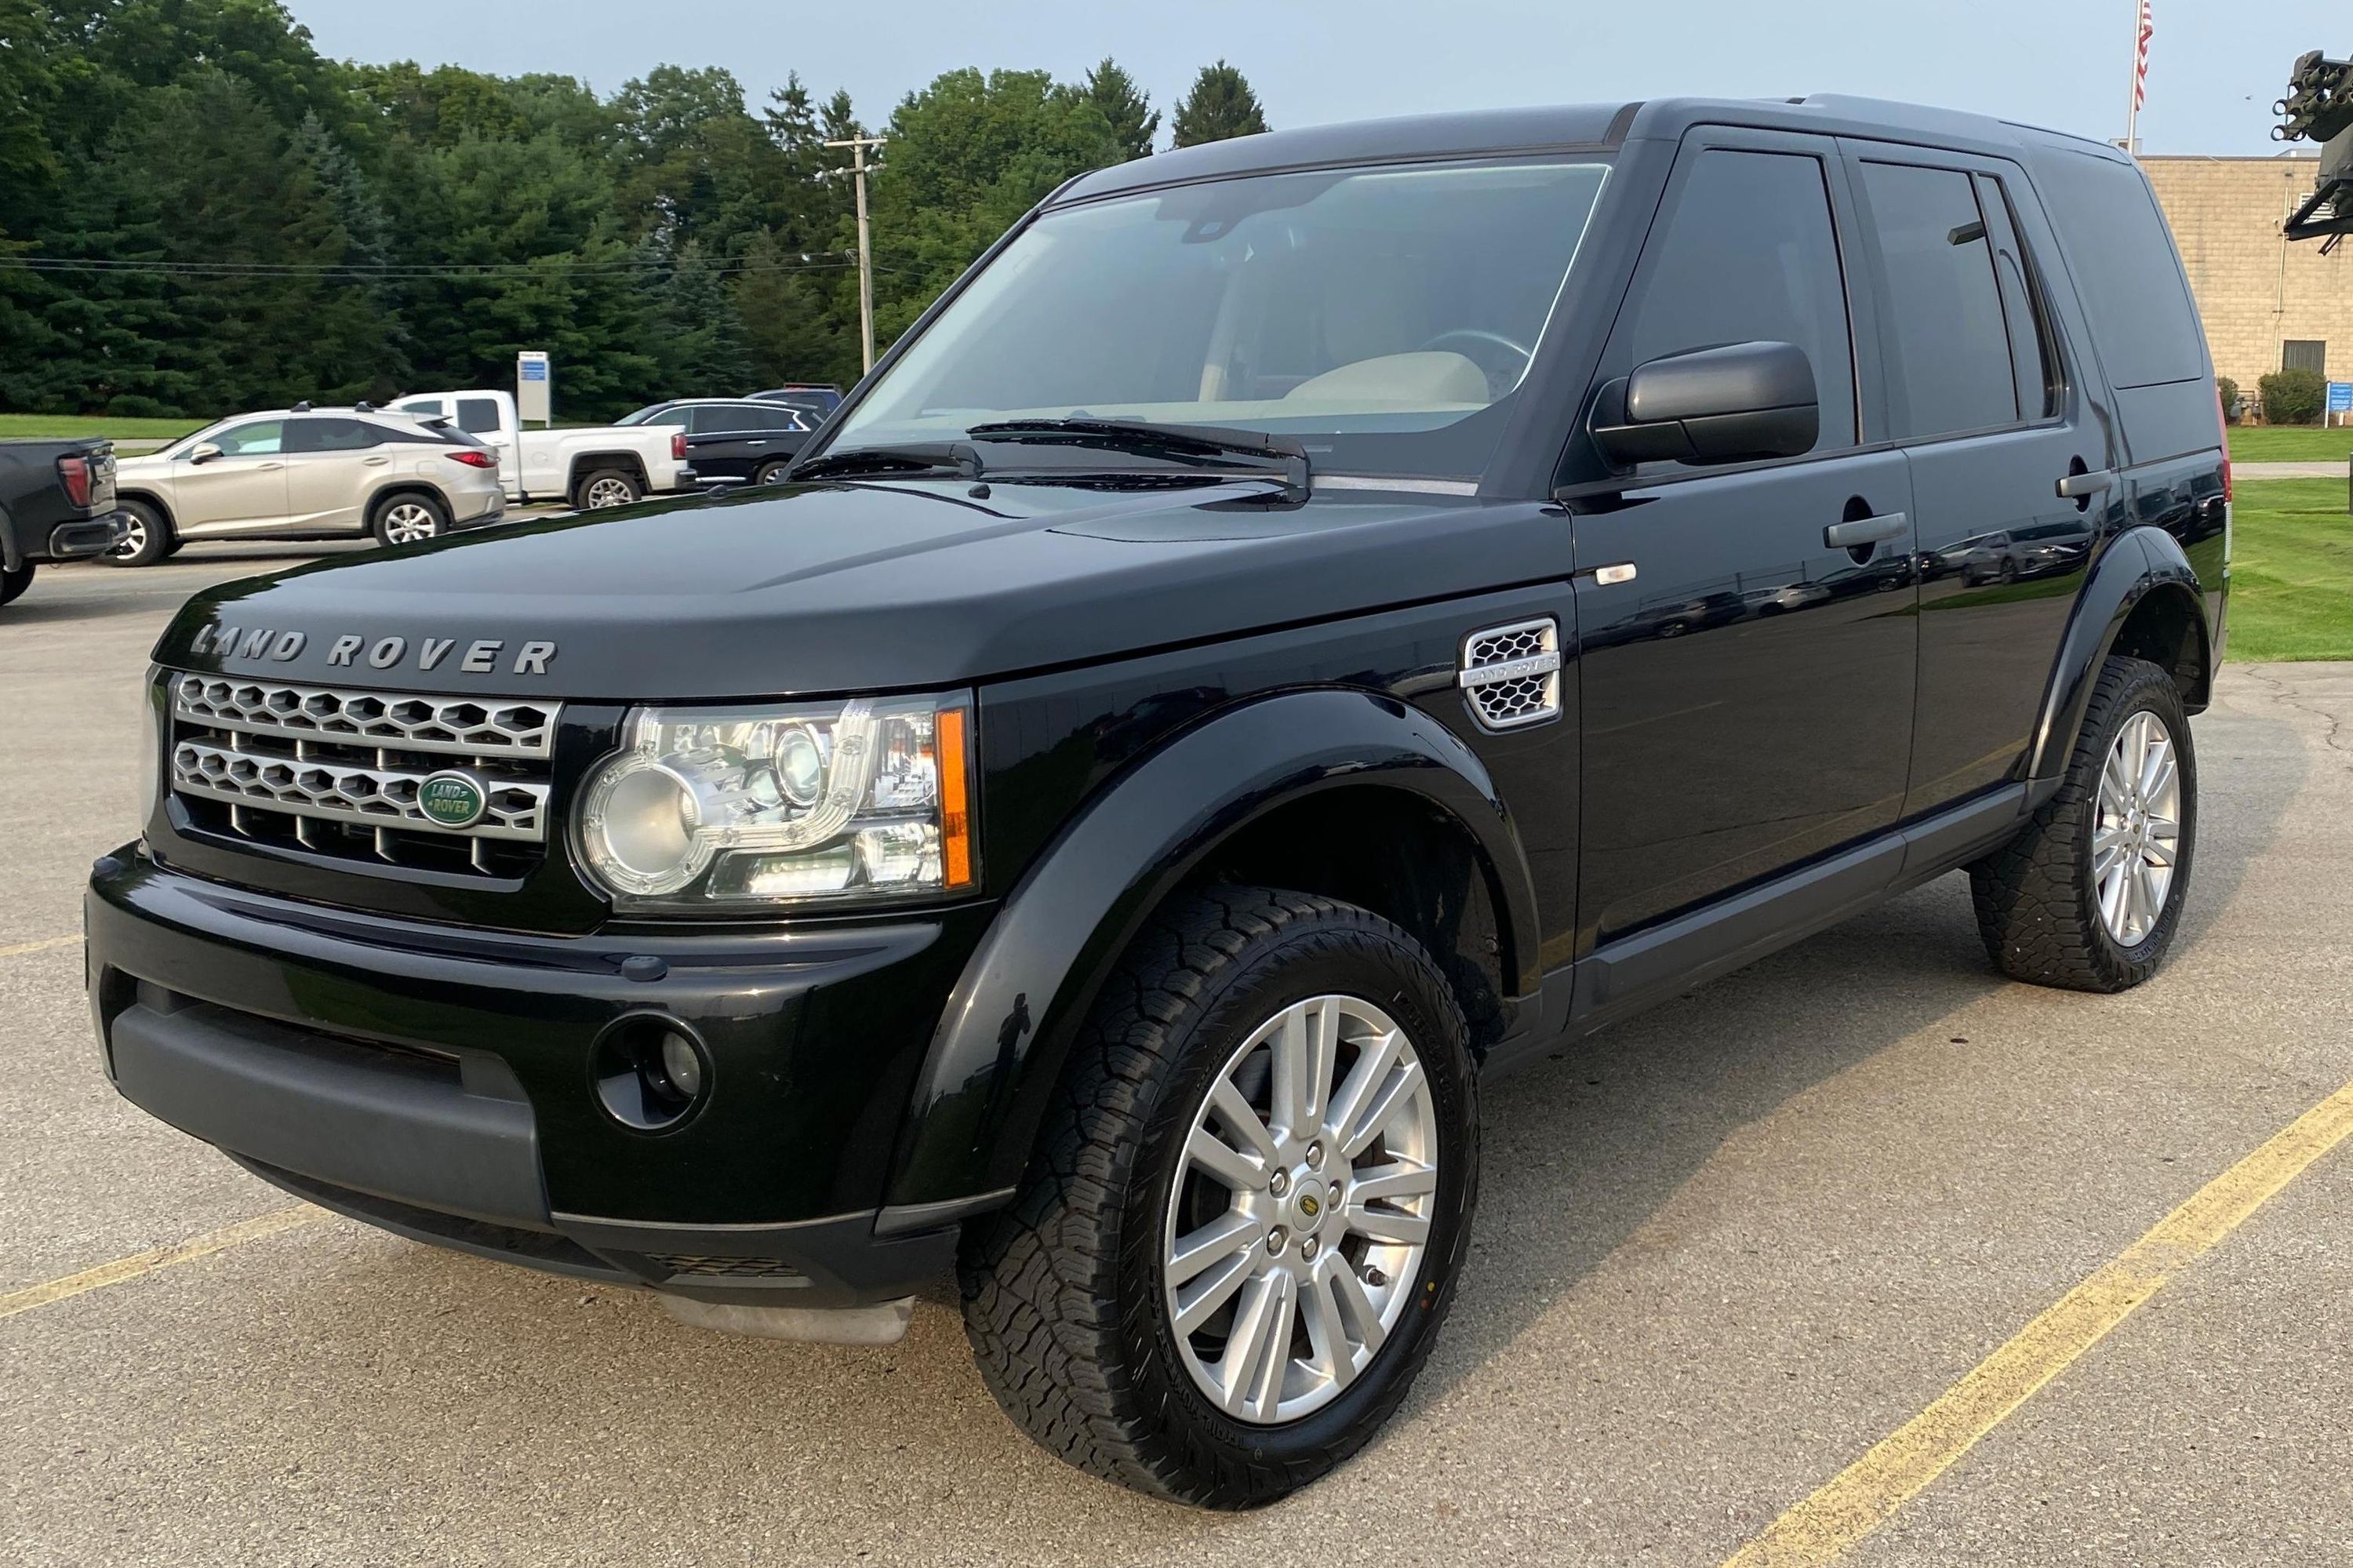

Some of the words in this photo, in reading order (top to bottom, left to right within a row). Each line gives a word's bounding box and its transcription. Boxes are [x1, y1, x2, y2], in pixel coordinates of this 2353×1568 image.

[190, 624, 307, 661] LAND
[326, 634, 558, 675] ROVER
[431, 784, 461, 799] LAND
[433, 799, 470, 814] ROVER
